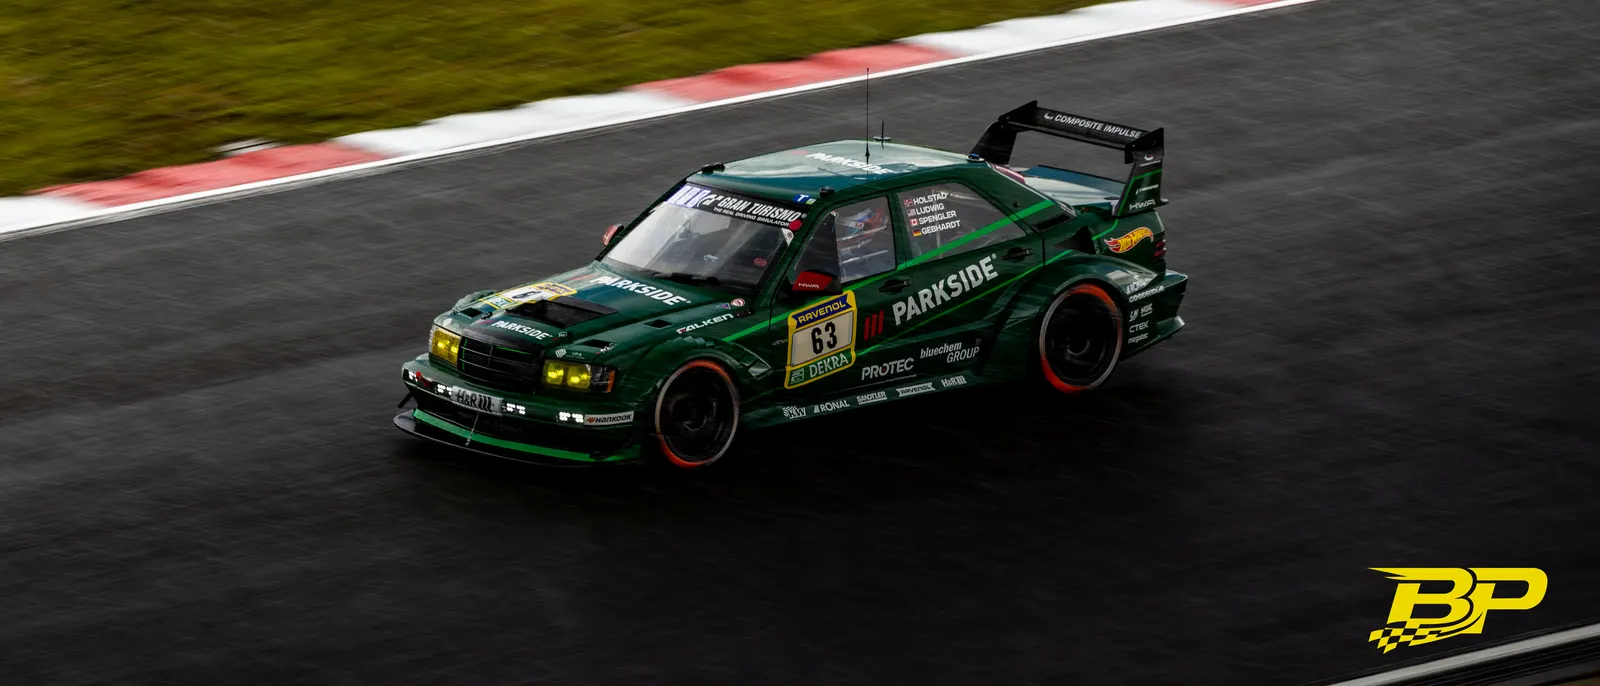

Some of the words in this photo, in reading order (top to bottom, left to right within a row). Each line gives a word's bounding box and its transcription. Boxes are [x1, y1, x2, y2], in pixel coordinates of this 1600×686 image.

[1054, 114, 1102, 131] COMPOSITE
[1103, 125, 1142, 138] IMPULSE
[718, 196, 748, 211] GRAN
[749, 203, 802, 223] TURISMO
[722, 209, 735, 217] REAL
[735, 211, 757, 220] DRIVING
[757, 215, 790, 227] SIMULATOR
[915, 203, 945, 215] LUDWIG
[918, 210, 957, 225] SPENGLER
[921, 219, 961, 235] GEBHARDT
[589, 275, 688, 306] PARKSIDE
[892, 255, 998, 326] PARKSIDE
[798, 301, 847, 324] RAVENOL
[492, 320, 550, 340] PARKSIDE
[1129, 320, 1149, 333] CTEK
[811, 321, 838, 354] 63
[920, 341, 962, 359] bluechem
[947, 346, 980, 363] GROUP
[809, 353, 849, 378] DEKRA
[861, 357, 915, 381] PROTEC
[856, 391, 886, 403] SANDTLER
[900, 385, 932, 395] RAVENOL
[821, 400, 850, 413] RONAL
